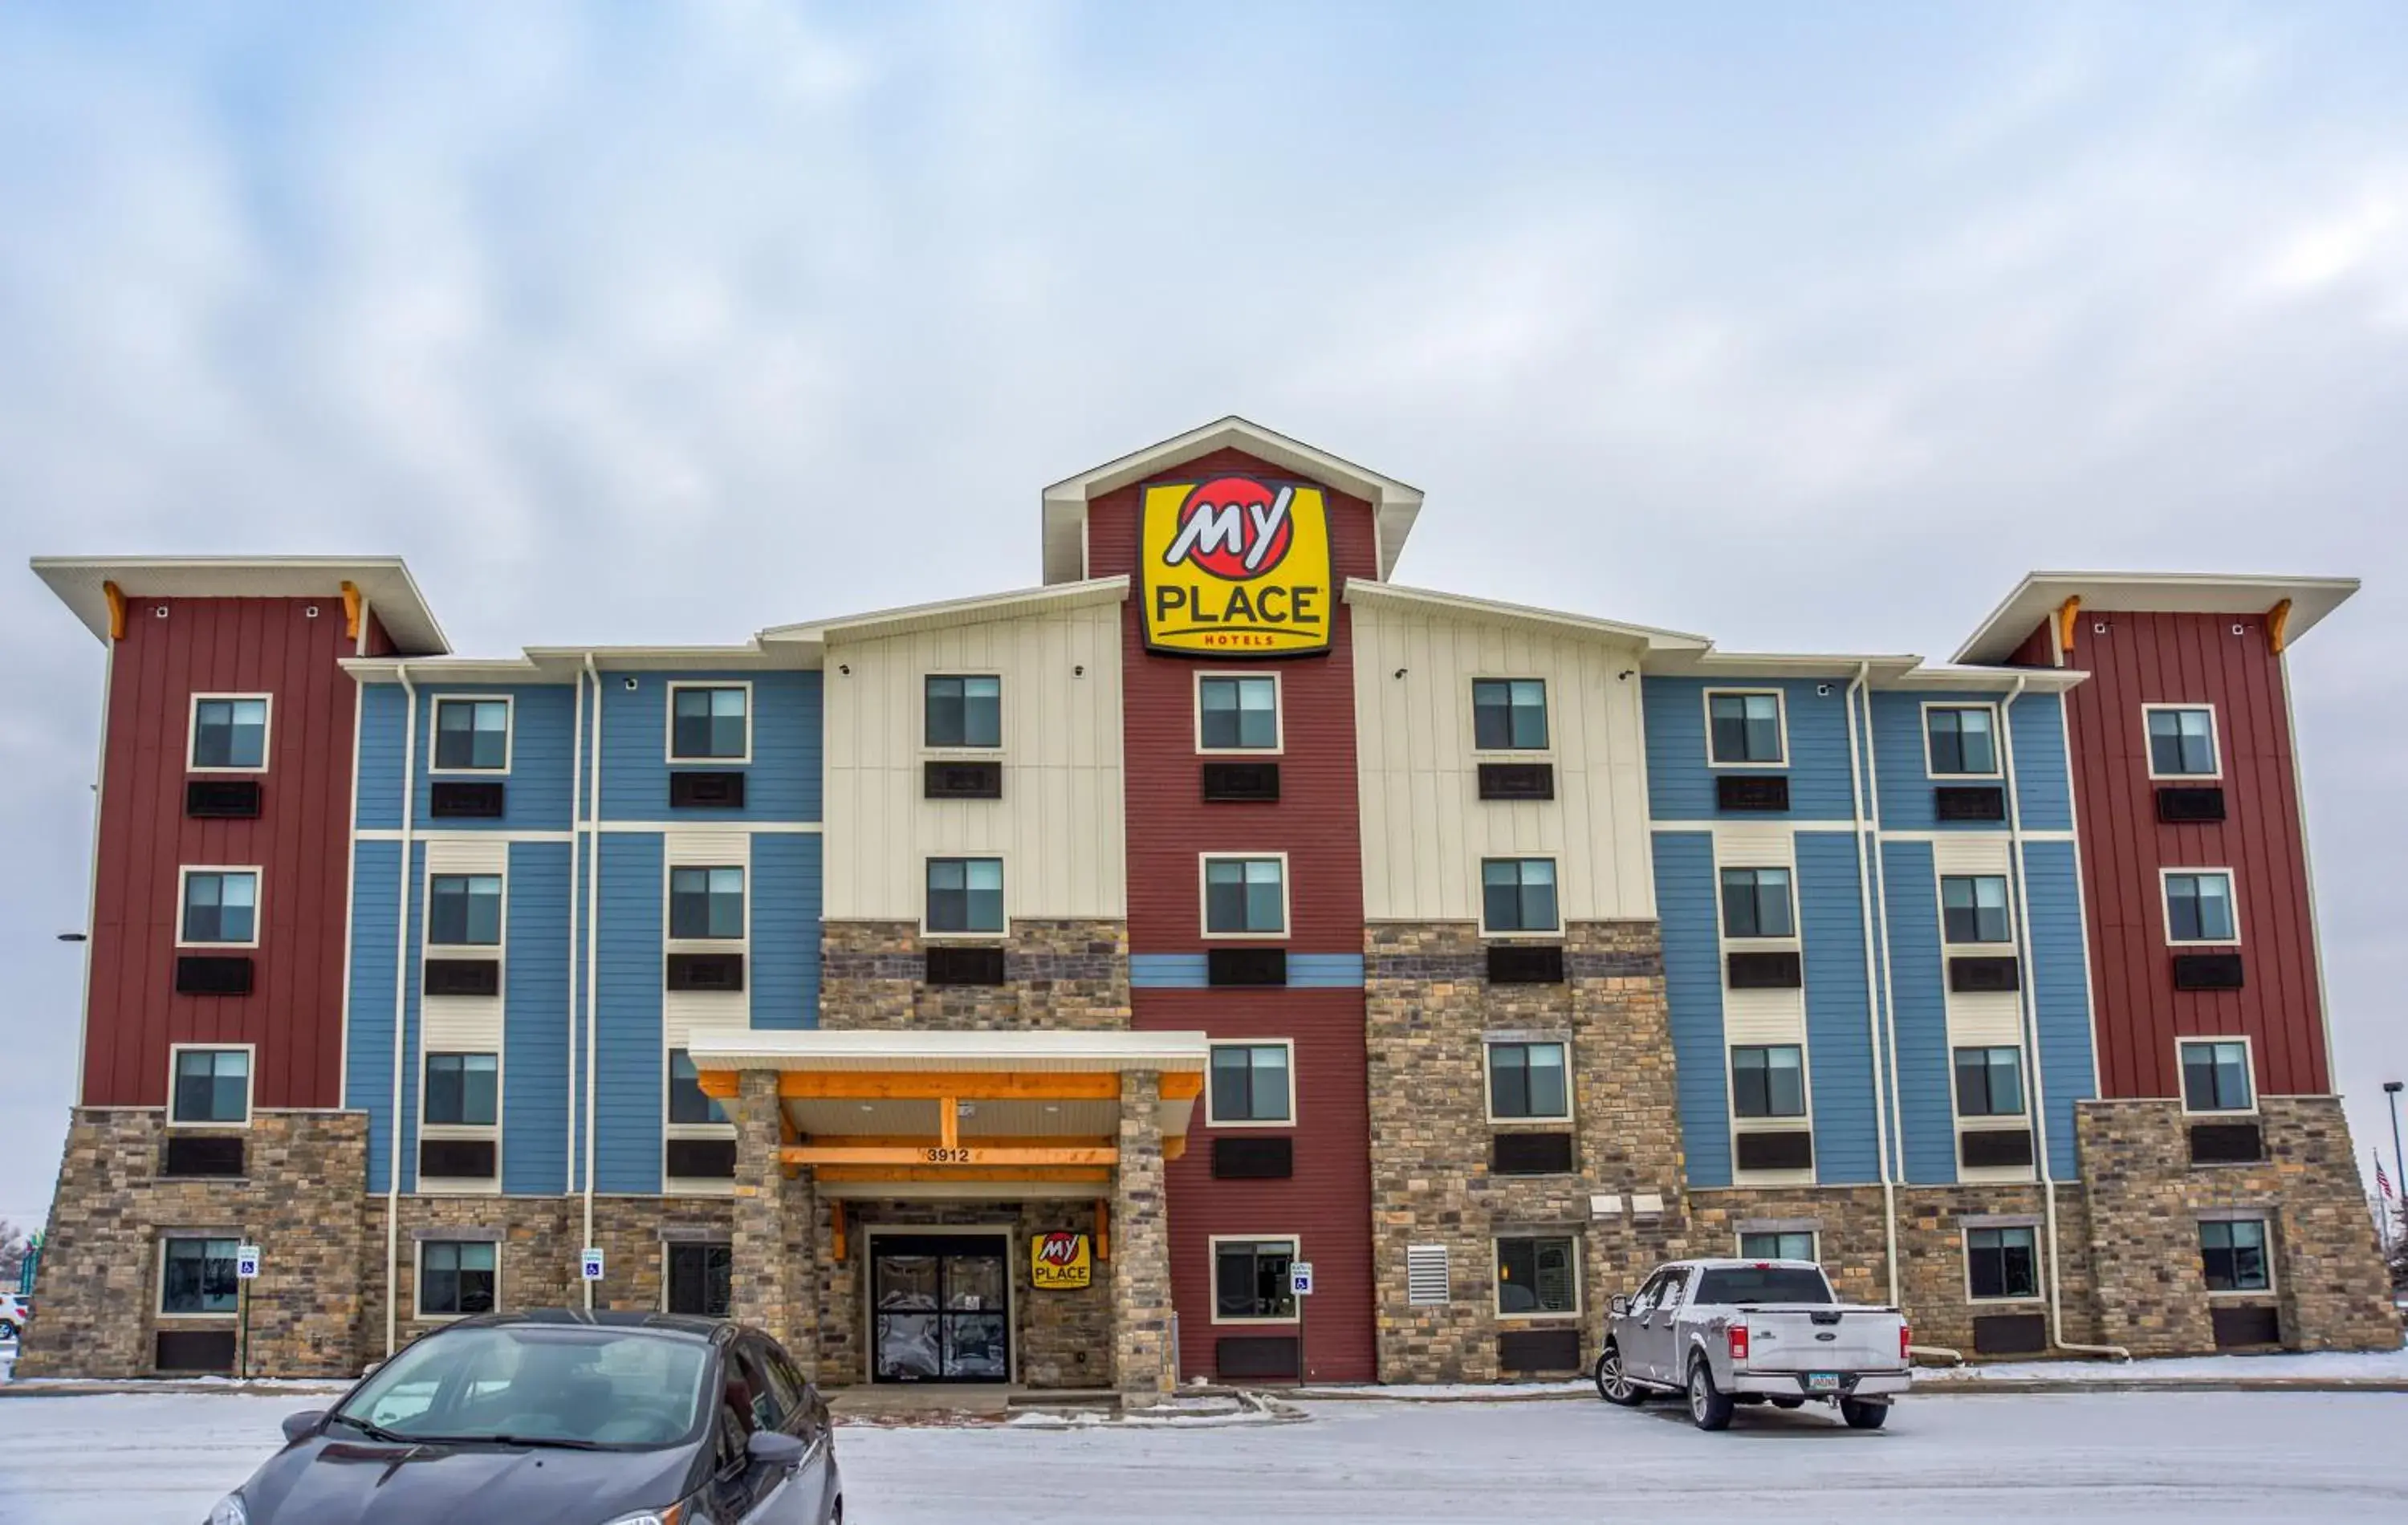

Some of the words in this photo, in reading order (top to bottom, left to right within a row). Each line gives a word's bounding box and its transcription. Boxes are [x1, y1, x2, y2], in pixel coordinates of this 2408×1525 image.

[1156, 585, 1320, 623] PLACE
[1205, 635, 1275, 645] HOTELS
[927, 1148, 969, 1162] 3912
[1035, 1267, 1088, 1280] PLACE
